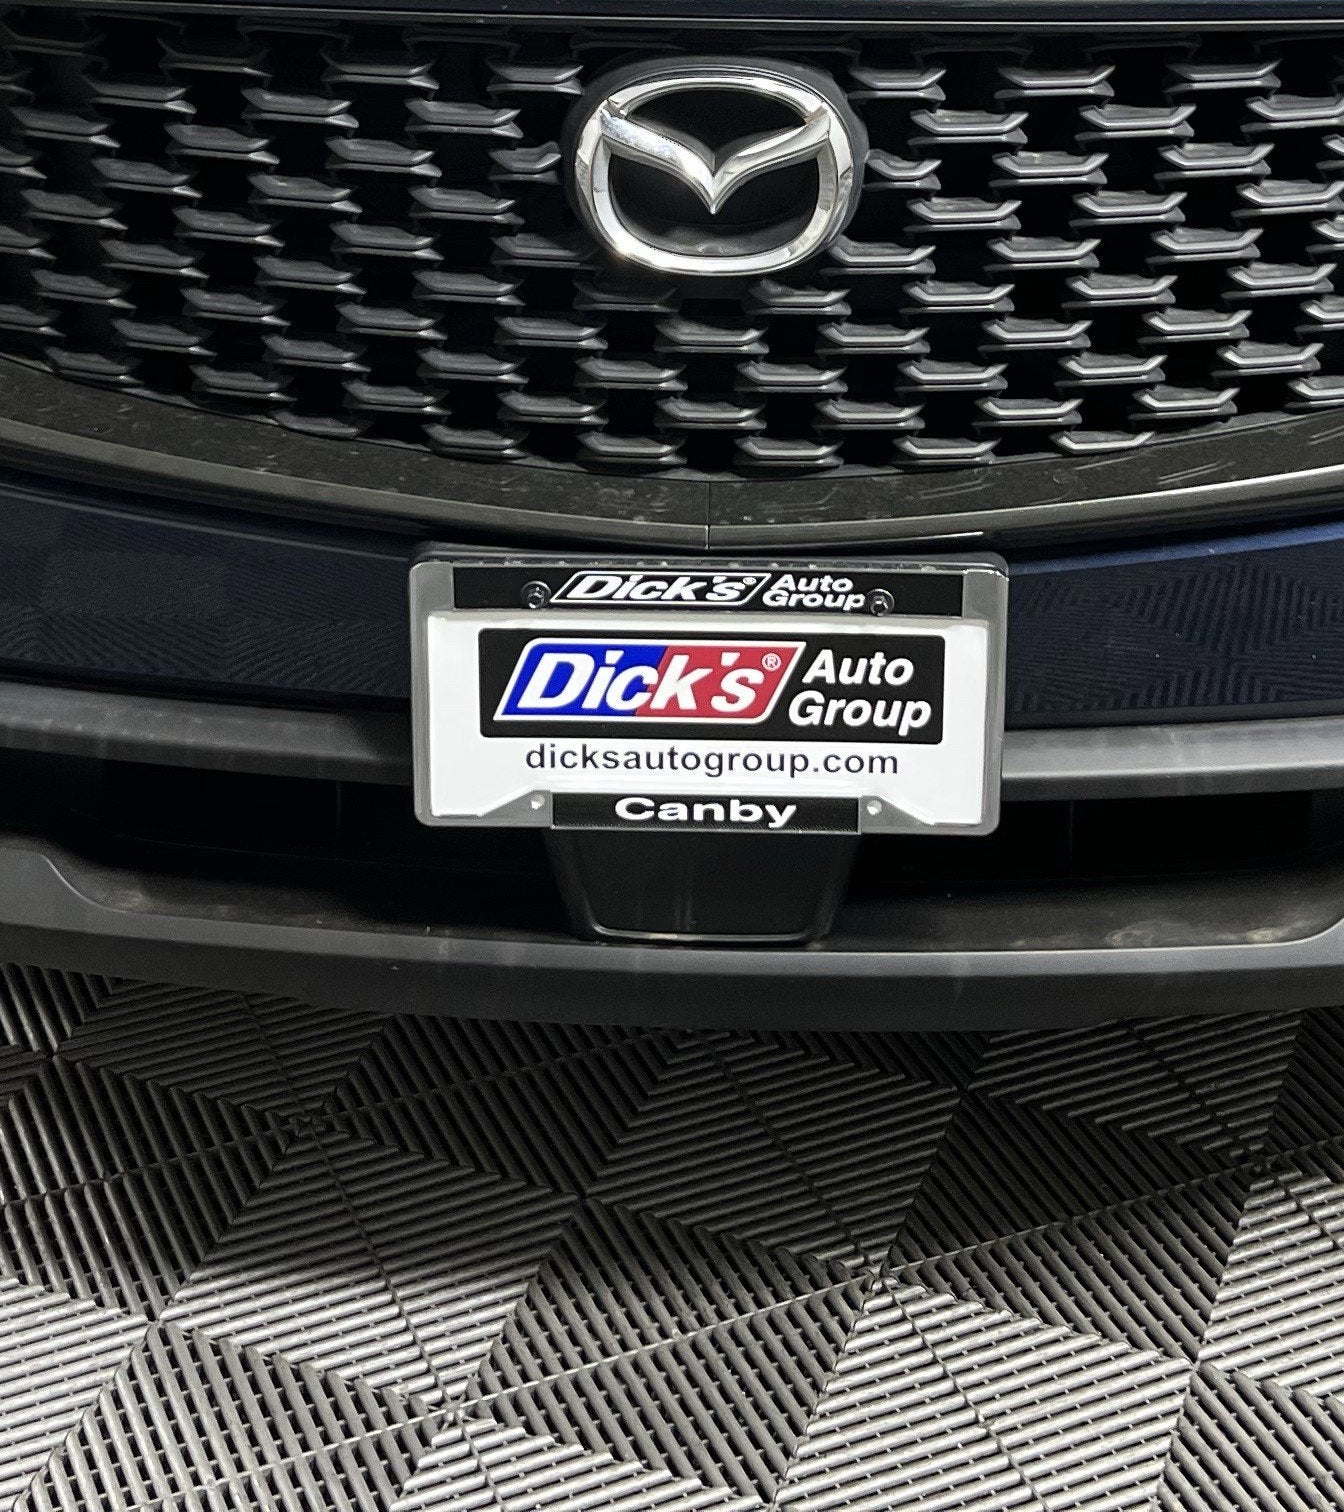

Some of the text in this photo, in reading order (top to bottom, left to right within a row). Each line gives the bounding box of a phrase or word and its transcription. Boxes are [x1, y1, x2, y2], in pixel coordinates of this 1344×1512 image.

[770, 574, 854, 592] Auto
[762, 590, 866, 611] Group
[802, 649, 914, 686] Auto
[788, 690, 932, 736] Group
[525, 743, 899, 779] dicksautogroup.com
[614, 796, 798, 829] Canby
